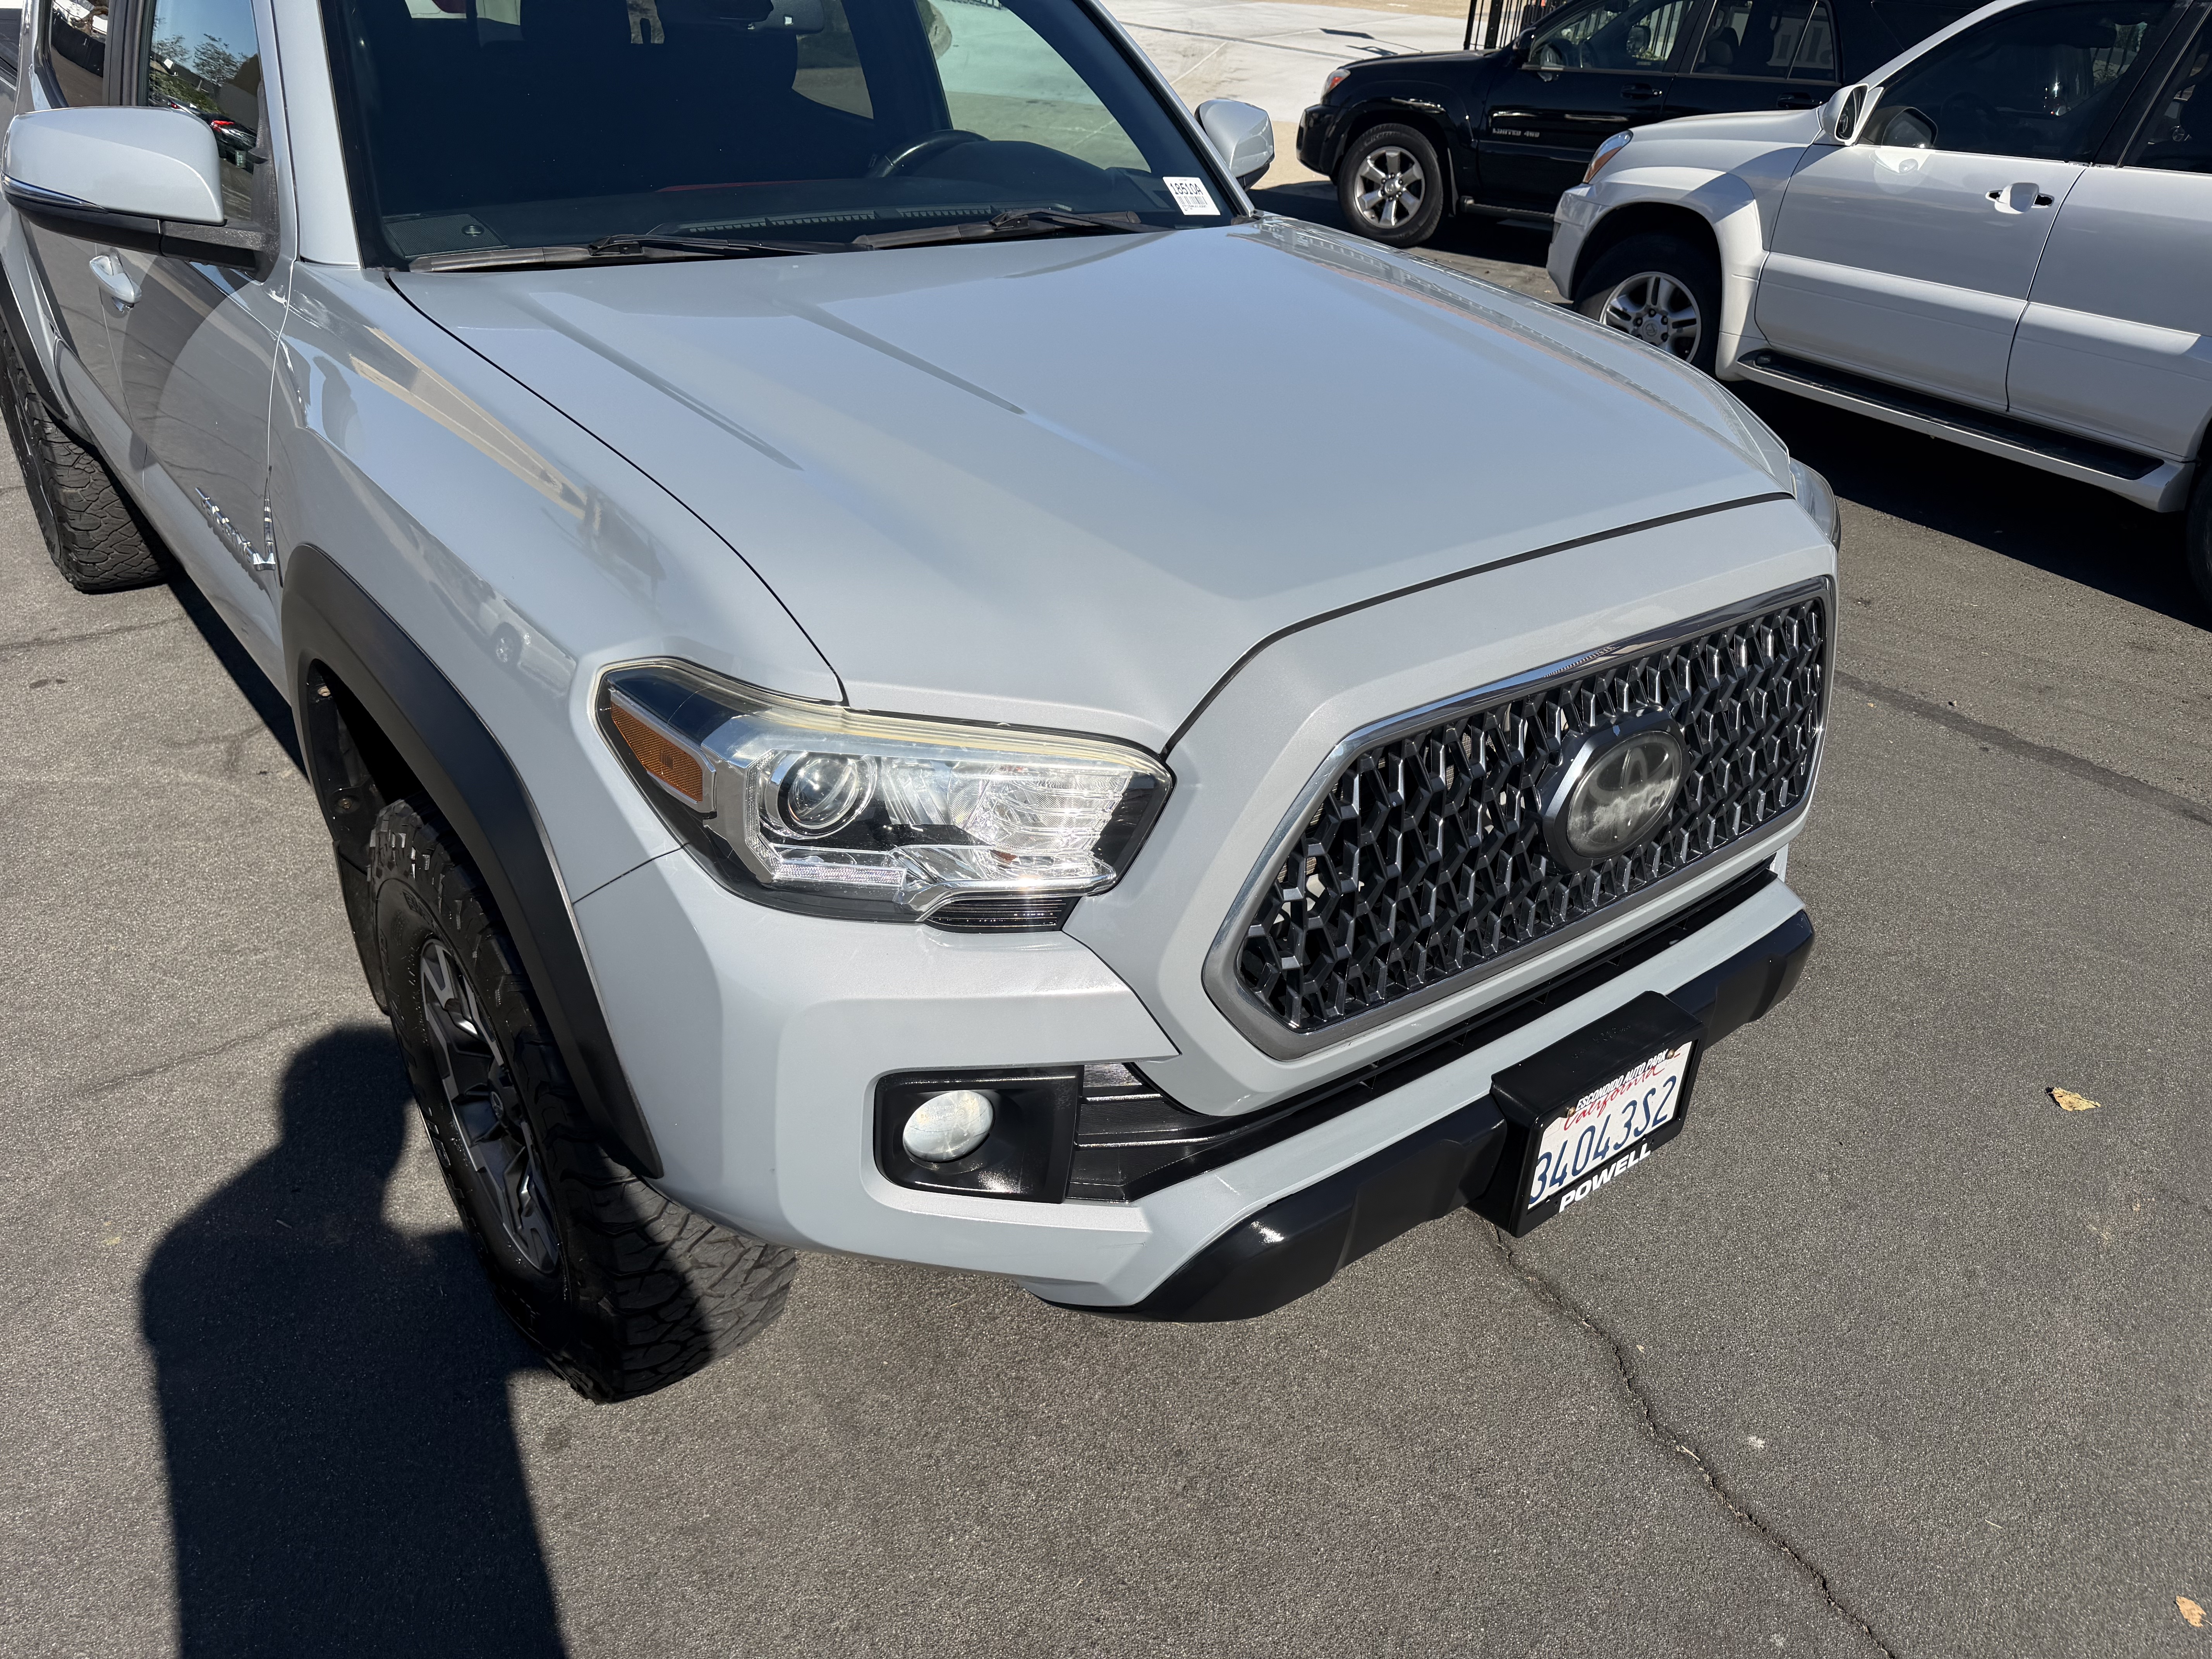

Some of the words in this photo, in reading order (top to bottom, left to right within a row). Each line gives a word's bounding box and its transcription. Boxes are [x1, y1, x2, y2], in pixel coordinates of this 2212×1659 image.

[1170, 183, 1204, 195] 18510A
[1564, 1065, 1665, 1131] California
[1575, 1075, 1625, 1111] ESCONDIDO
[1623, 1062, 1646, 1083] AUTO
[1645, 1048, 1669, 1071] PARK
[1528, 1075, 1677, 1204] 34043S2
[1559, 1143, 1651, 1213] POWELL
